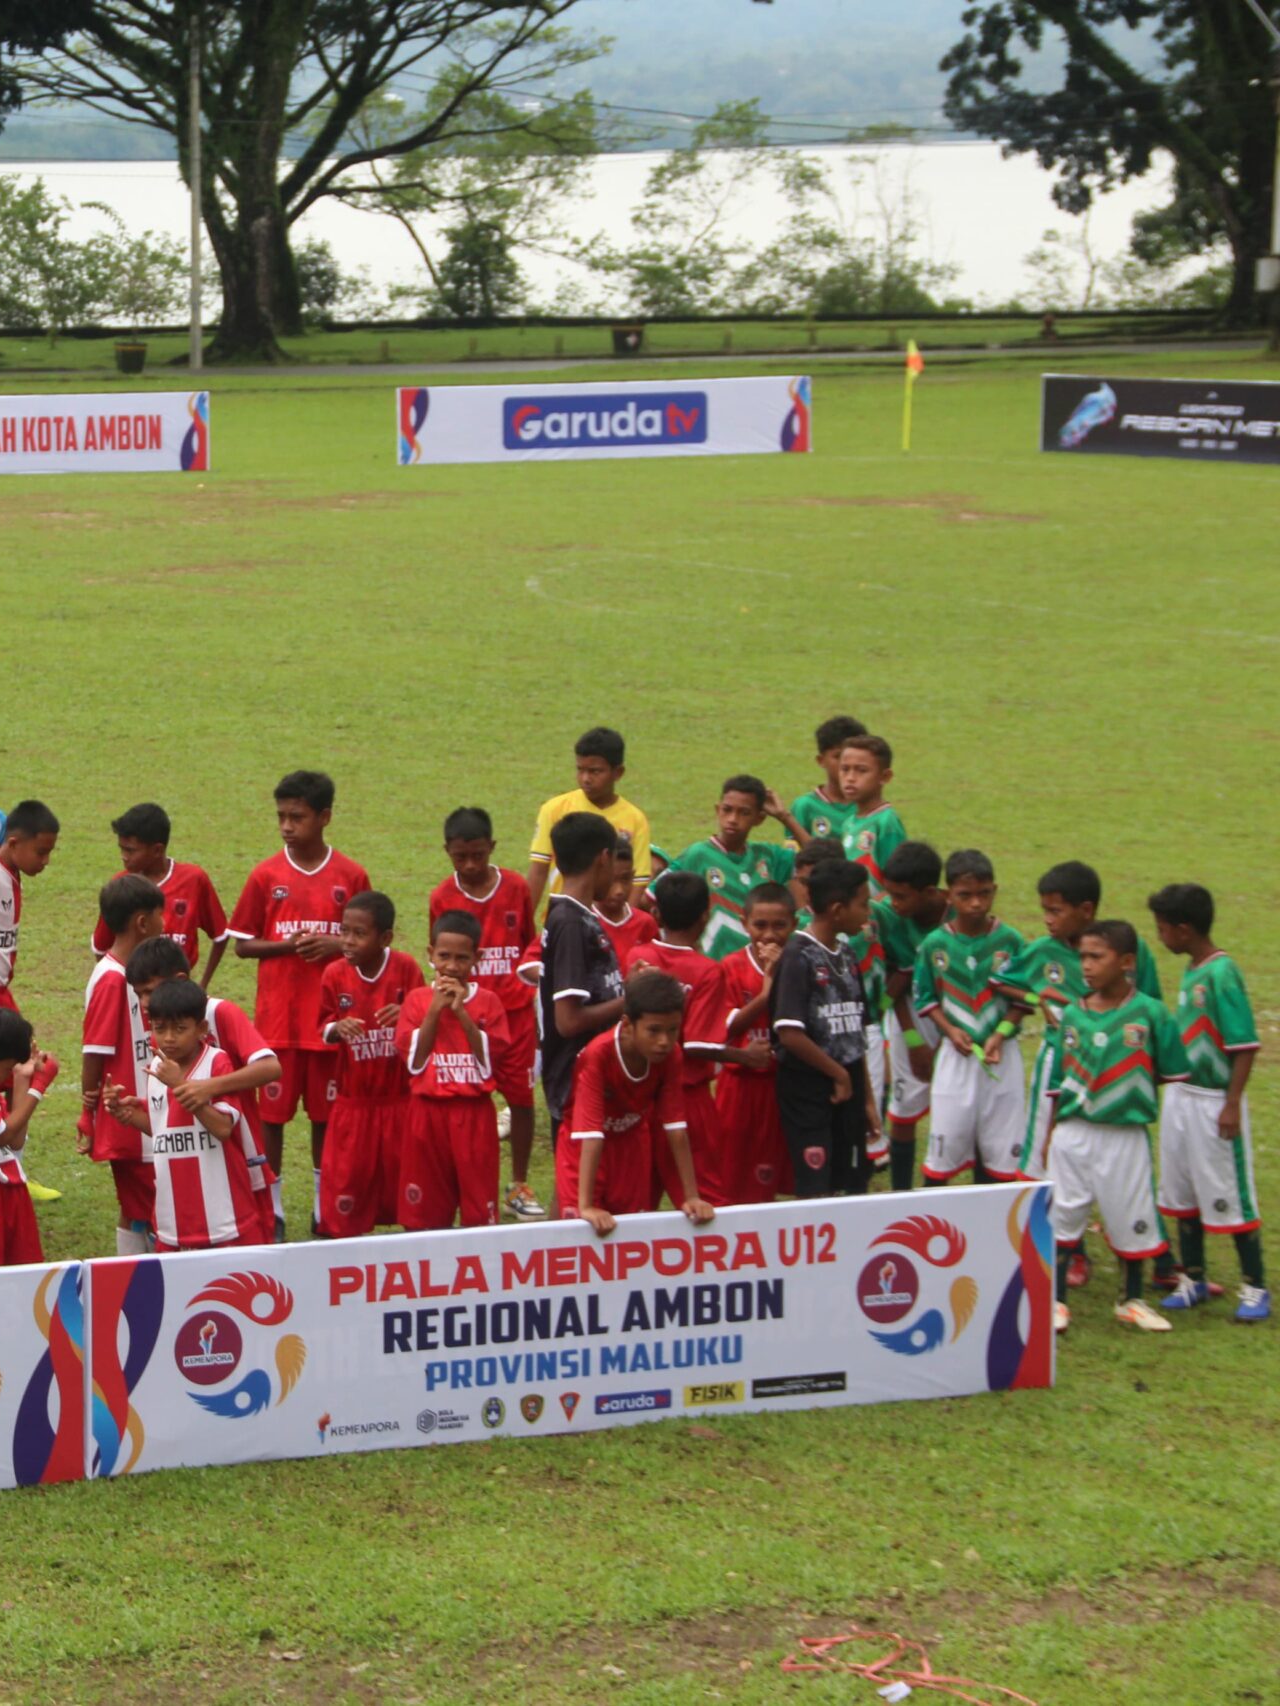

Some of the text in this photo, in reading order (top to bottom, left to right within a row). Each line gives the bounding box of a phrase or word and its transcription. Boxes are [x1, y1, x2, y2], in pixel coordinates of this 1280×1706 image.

[22, 416, 79, 452] KOTA
[83, 414, 163, 450] AMBON
[1120, 414, 1231, 434] REBORN
[504, 946, 519, 959] FC
[347, 1026, 395, 1044] ALUKU
[326, 1079, 337, 1101] 6
[328, 1222, 837, 1307] PIALA MENPORA U12
[382, 1278, 785, 1354] REGIONAL AMBON
[425, 1333, 744, 1392] PROVINSI MALUKU
[690, 1383, 736, 1403] FISIK
[330, 1420, 400, 1437] KEMENPORA
